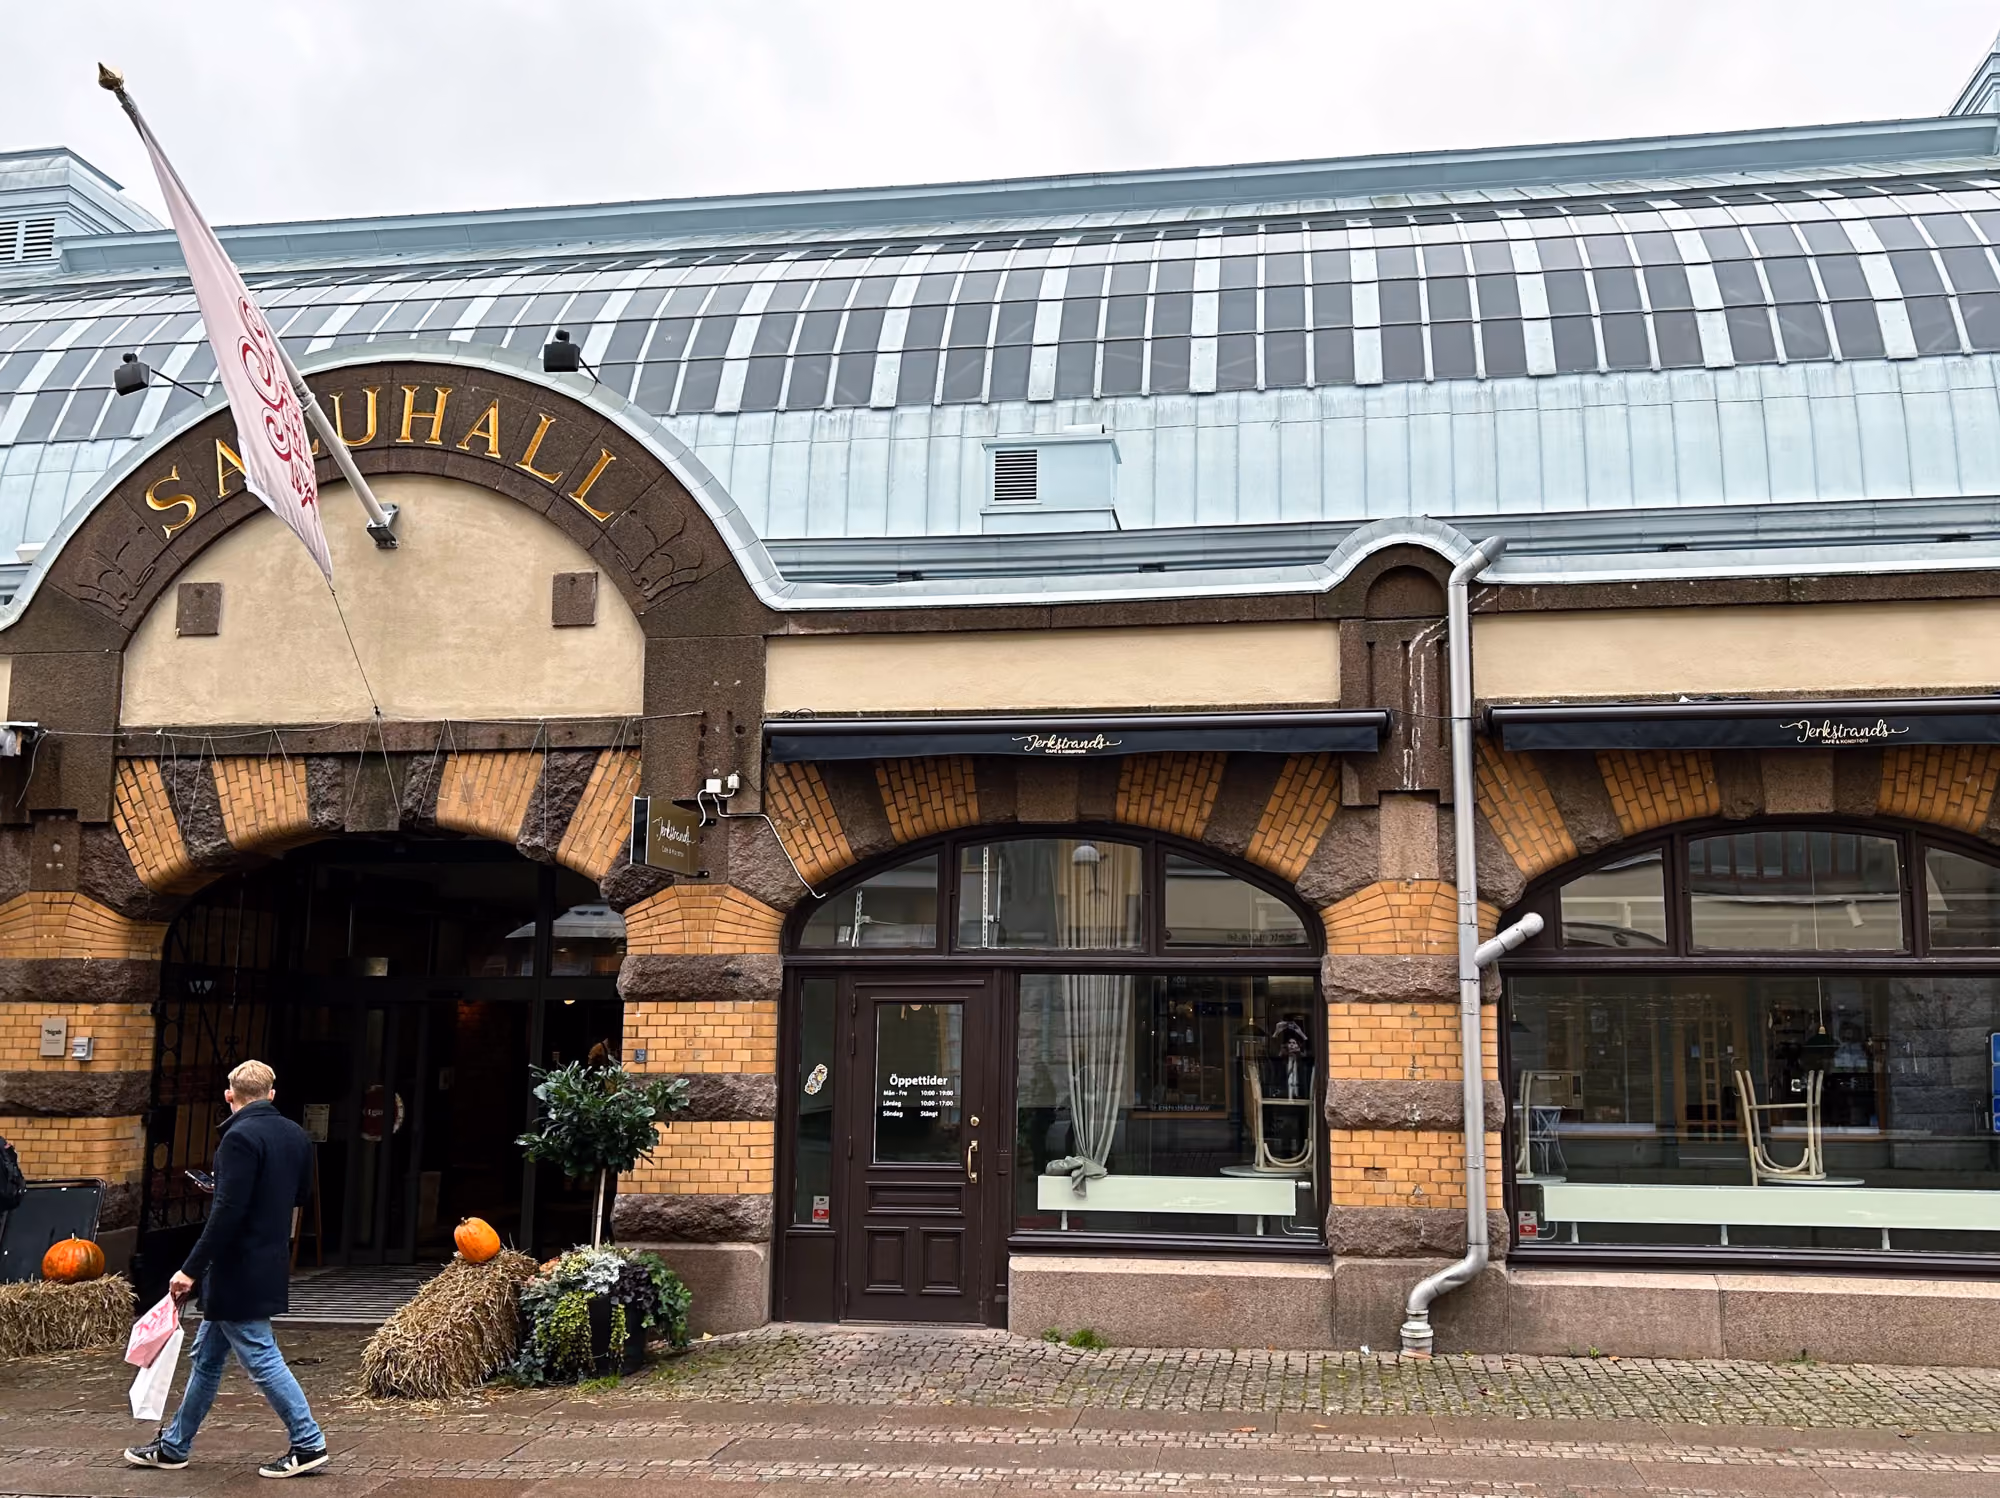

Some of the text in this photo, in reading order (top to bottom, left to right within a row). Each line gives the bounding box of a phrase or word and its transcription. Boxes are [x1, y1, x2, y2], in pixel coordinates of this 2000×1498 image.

[146, 385, 616, 539] SAUHALL
[1780, 719, 1909, 742] Jerkstrands
[1011, 734, 1122, 751] Jerkstrands
[889, 1073, 948, 1088] Öppettider
[883, 1100, 902, 1108] Lördag
